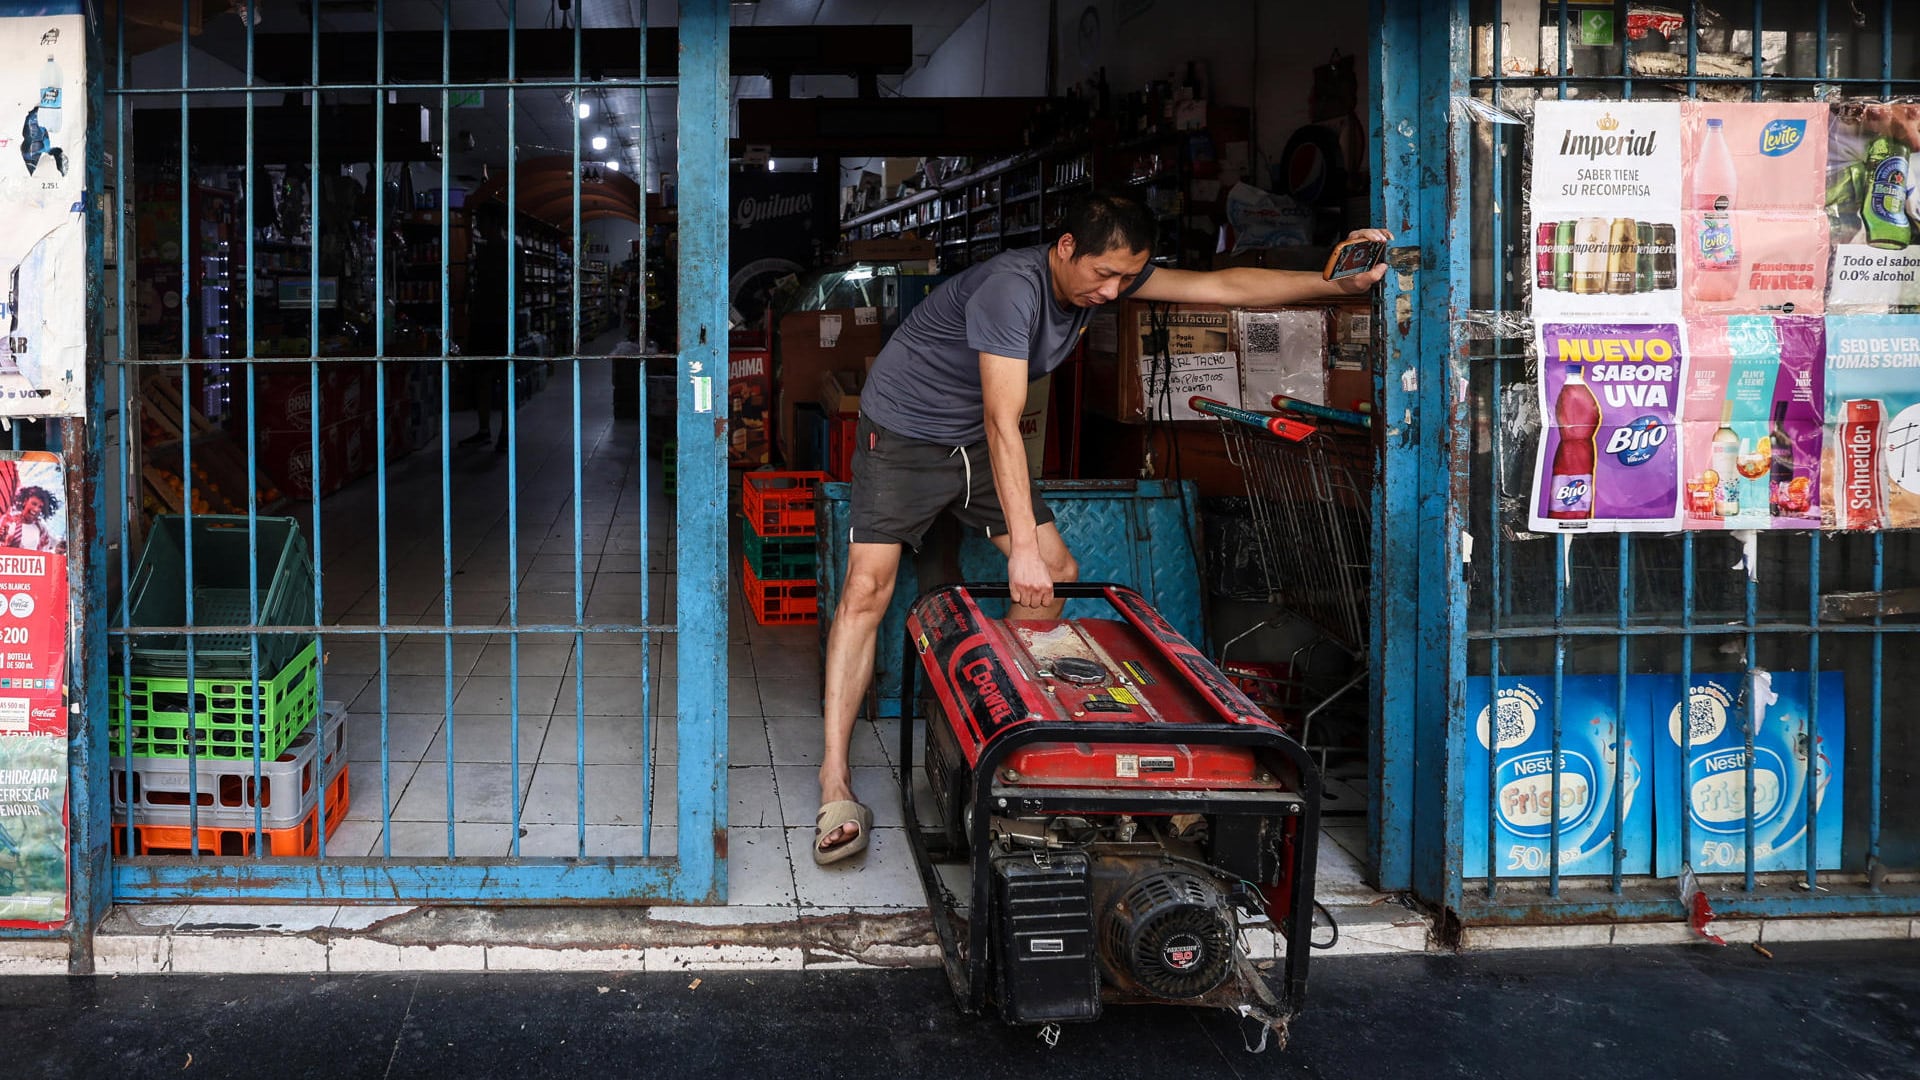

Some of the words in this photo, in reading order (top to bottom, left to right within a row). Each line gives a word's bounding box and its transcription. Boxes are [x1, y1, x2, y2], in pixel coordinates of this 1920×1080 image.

[1560, 129, 1656, 161] Imperial
[1763, 127, 1800, 152] Levite
[1577, 169, 1611, 181] SABER
[1614, 169, 1639, 181] TIENE
[1562, 184, 1578, 196] SU
[1581, 184, 1651, 196] RECOMPENSA
[1843, 256, 1874, 267] Todo
[1877, 256, 1888, 267] el
[1839, 270, 1870, 281] 0.0%
[1872, 270, 1914, 282] alcohol
[1186, 314, 1223, 325] factura
[1557, 338, 1673, 362] NUEVO
[1871, 338, 1889, 353] DE
[1193, 355, 1226, 367] TACHO
[1827, 350, 1879, 369] TOMÁS
[728, 358, 764, 380] AHMA
[1591, 364, 1673, 382] SABOR
[1603, 384, 1668, 408] UVA
[1848, 425, 1872, 510] Schneider
[0, 769, 58, 785] EHIDRATAR
[1507, 844, 1543, 871] 50
[1701, 840, 1735, 867] 50
